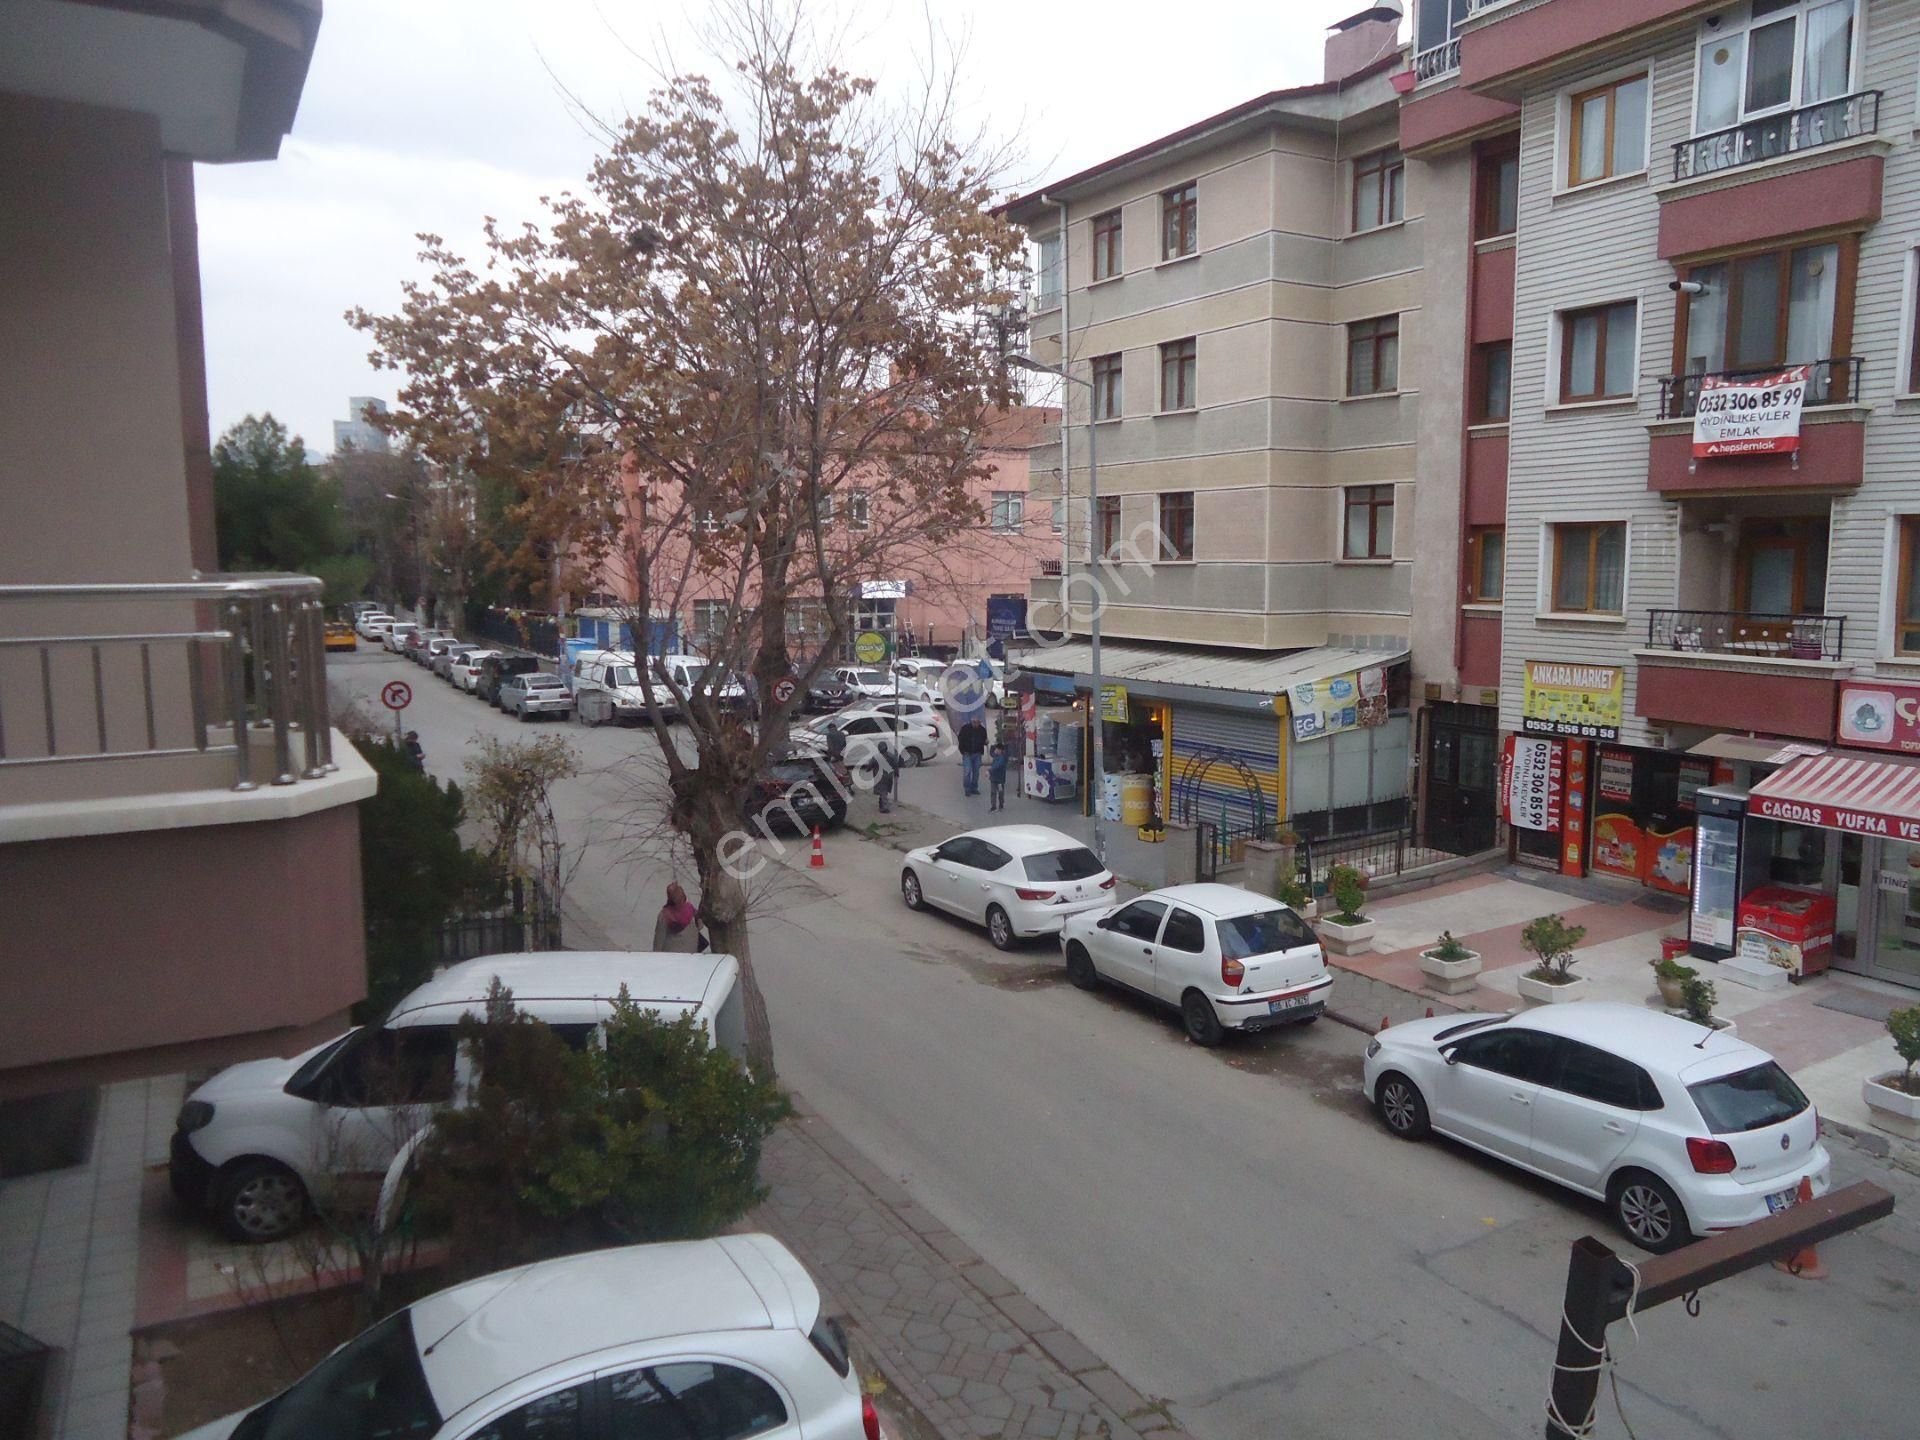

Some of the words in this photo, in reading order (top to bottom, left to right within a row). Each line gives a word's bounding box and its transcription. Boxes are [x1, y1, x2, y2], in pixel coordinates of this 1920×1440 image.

[1699, 393, 1727, 413] 0532
[1729, 392, 1757, 411] 306
[1761, 390, 1782, 409] 85
[1783, 387, 1801, 406] 99
[1700, 410, 1791, 426] AYDINLIKEVLER
[1719, 426, 1761, 439] EMLAK
[1719, 440, 1775, 453] hepsiemlak
[1532, 665, 1571, 685] ANKARA
[1571, 667, 1614, 689] MARKET
[1526, 720, 1554, 732] 0552
[1557, 723, 1579, 734] 556
[1600, 728, 1615, 739] 58
[1532, 743, 1547, 771] 0532
[1512, 765, 1520, 797] EMLAK
[1531, 774, 1545, 794] 306
[1547, 745, 1562, 829] KIRALIK
[1530, 795, 1543, 811] 85
[1529, 812, 1542, 827] 99
[1836, 811, 1887, 834] YUFKA
